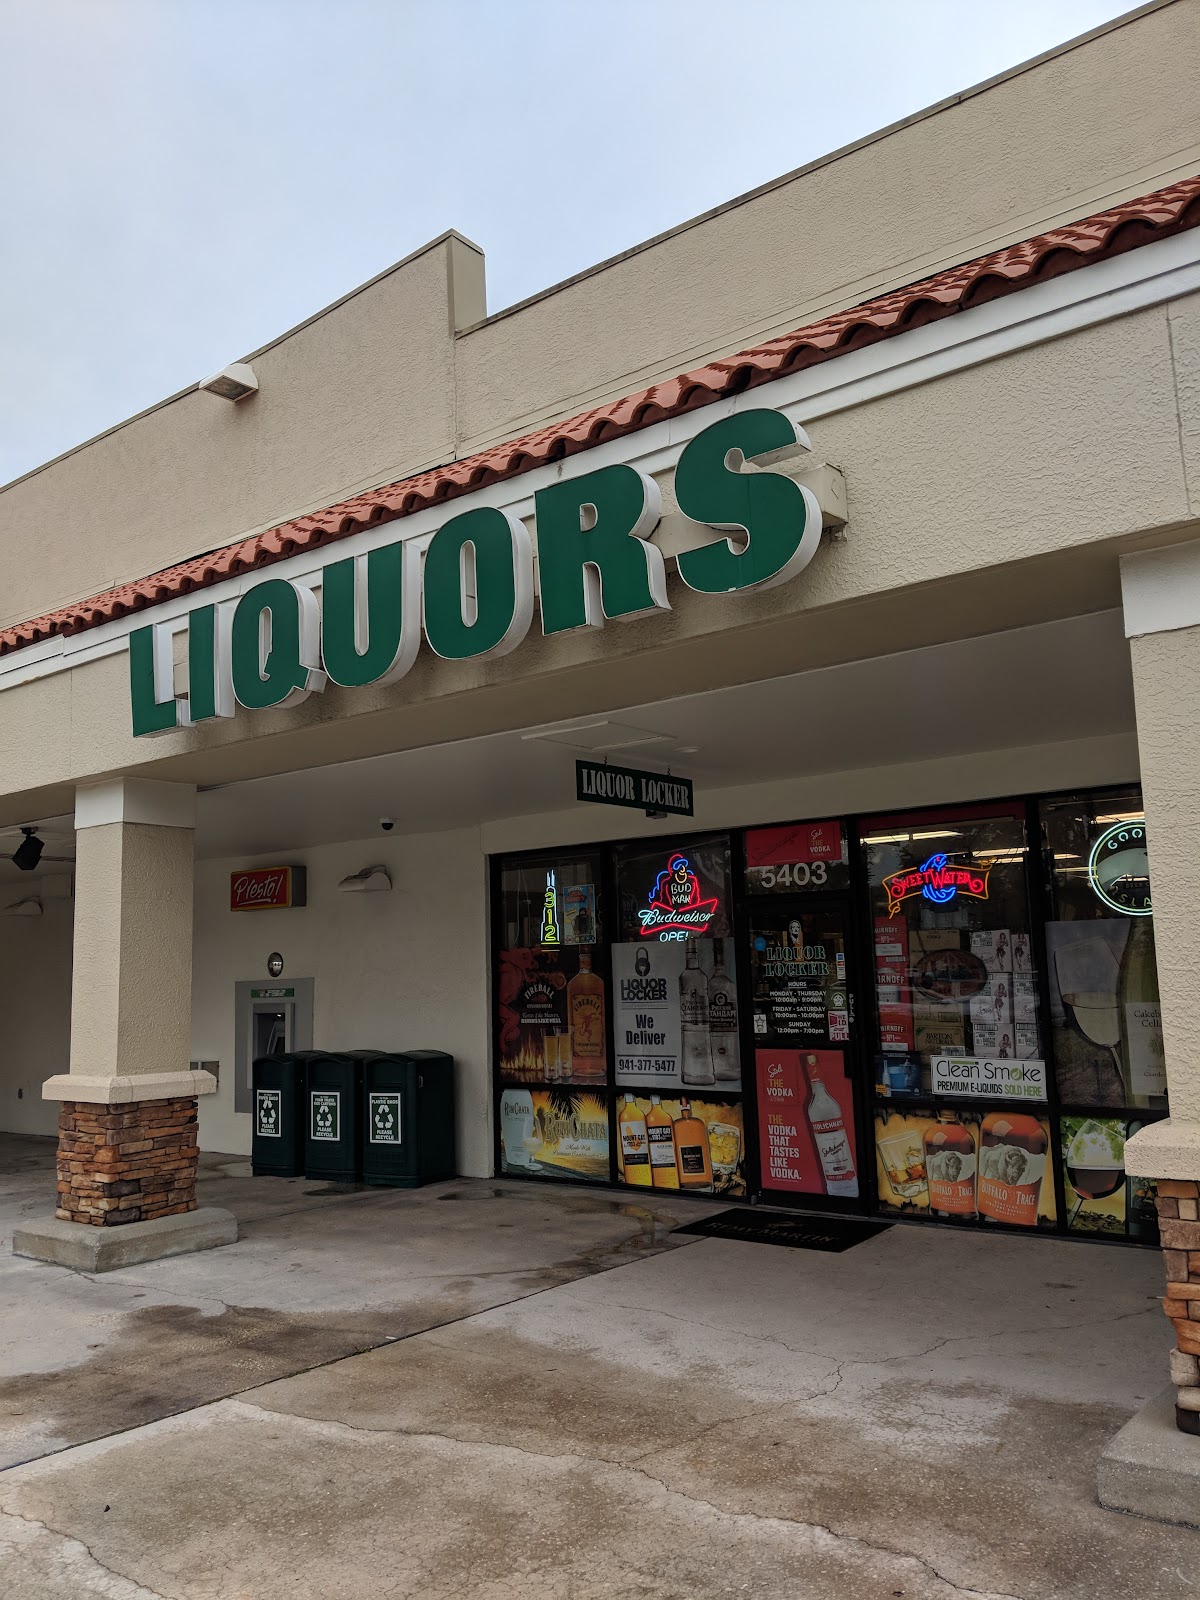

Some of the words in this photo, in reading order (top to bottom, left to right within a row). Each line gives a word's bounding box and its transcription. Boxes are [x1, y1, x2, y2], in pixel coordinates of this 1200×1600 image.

[130, 407, 822, 738] LIQUORS
[582, 768, 635, 800] LIQUOR
[641, 778, 689, 809] LOCKER
[812, 839, 824, 847] THE
[1107, 828, 1143, 850] GOO
[809, 845, 831, 853] VODKA
[761, 861, 828, 888] 5403
[233, 875, 284, 906] Presto!
[671, 882, 692, 894] BUD
[671, 893, 690, 905] MAN
[1111, 885, 1152, 908] ISLA
[638, 908, 715, 926] Budweiser
[766, 945, 826, 961] LIQUOR
[765, 962, 829, 977] LOCKER
[620, 978, 667, 991] LIQUOR
[878, 975, 905, 985] IRNOFF
[523, 983, 556, 1000] FIREBALL
[621, 990, 668, 1001] LOCKER
[574, 998, 601, 1012] FIREBALL
[1133, 1009, 1161, 1018] Cakeb
[635, 1014, 654, 1029] We
[1141, 1019, 1162, 1028] Cell
[625, 1030, 666, 1045] Deliver
[830, 1032, 850, 1041] PULL
[619, 1059, 676, 1072] 941-377-5477
[936, 1060, 980, 1079] Clean
[768, 1078, 784, 1088] THE
[937, 1080, 969, 1093] PREMIUM
[970, 1083, 1003, 1095] E-LIQUIDS
[1004, 1084, 1022, 1096] SOLD
[1023, 1085, 1042, 1097] HERE
[766, 1087, 794, 1097] VODKA
[768, 1114, 784, 1125] THE
[768, 1124, 797, 1137] VODKA
[769, 1135, 790, 1147] THAT
[769, 1146, 800, 1159] TASTES
[770, 1157, 788, 1168] LIKE
[770, 1167, 802, 1180] VODKA.
[932, 1183, 953, 1196] BUFFALO
[957, 1185, 973, 1197] TRACE
[981, 1181, 1008, 1201] BUFFALO
[1016, 1190, 1036, 1206] TRACE
